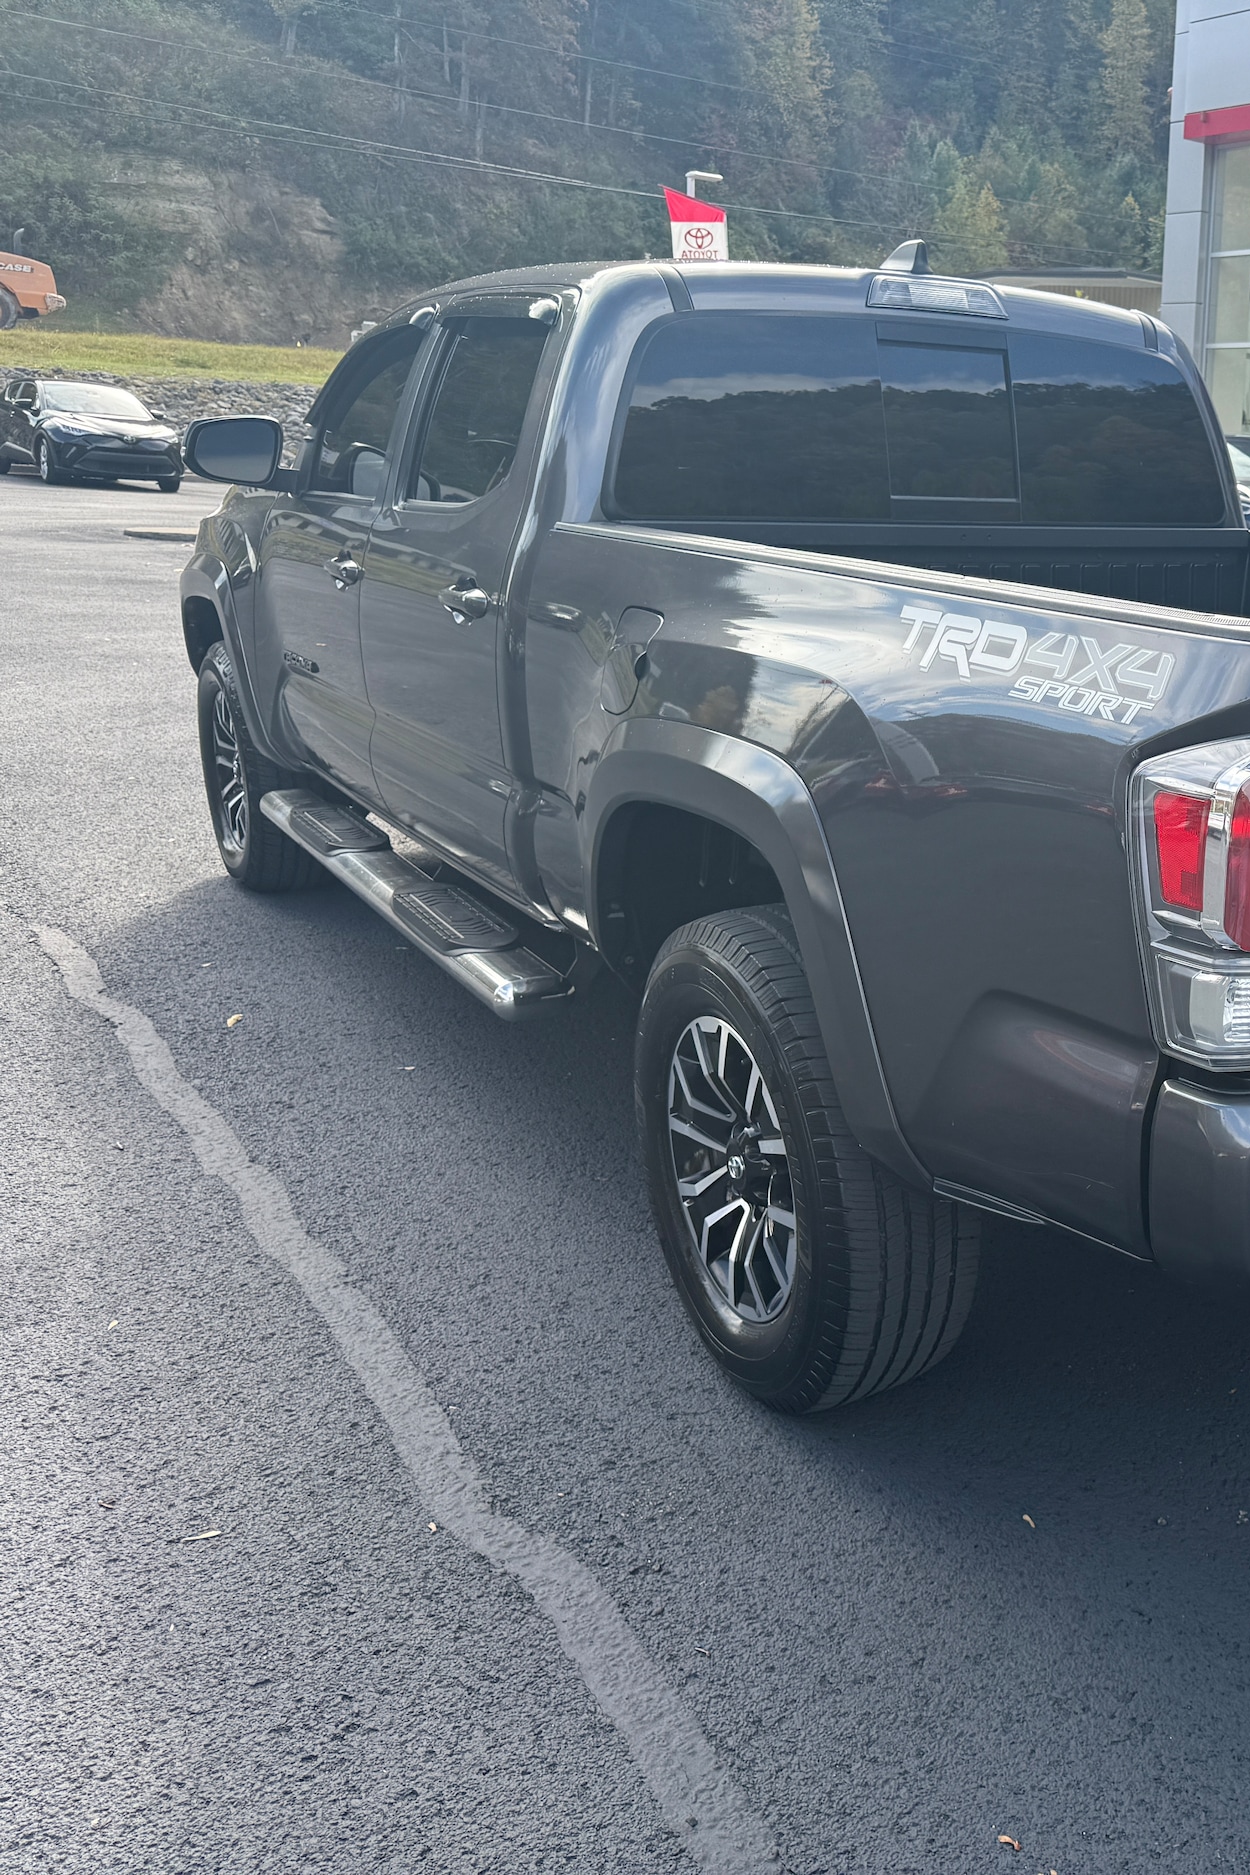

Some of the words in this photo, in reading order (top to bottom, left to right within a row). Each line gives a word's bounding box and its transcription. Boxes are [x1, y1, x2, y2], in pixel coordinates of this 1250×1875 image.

[0, 262, 32, 273] CASE
[900, 605, 1028, 683] TRD
[1008, 675, 1155, 725] SPORT
